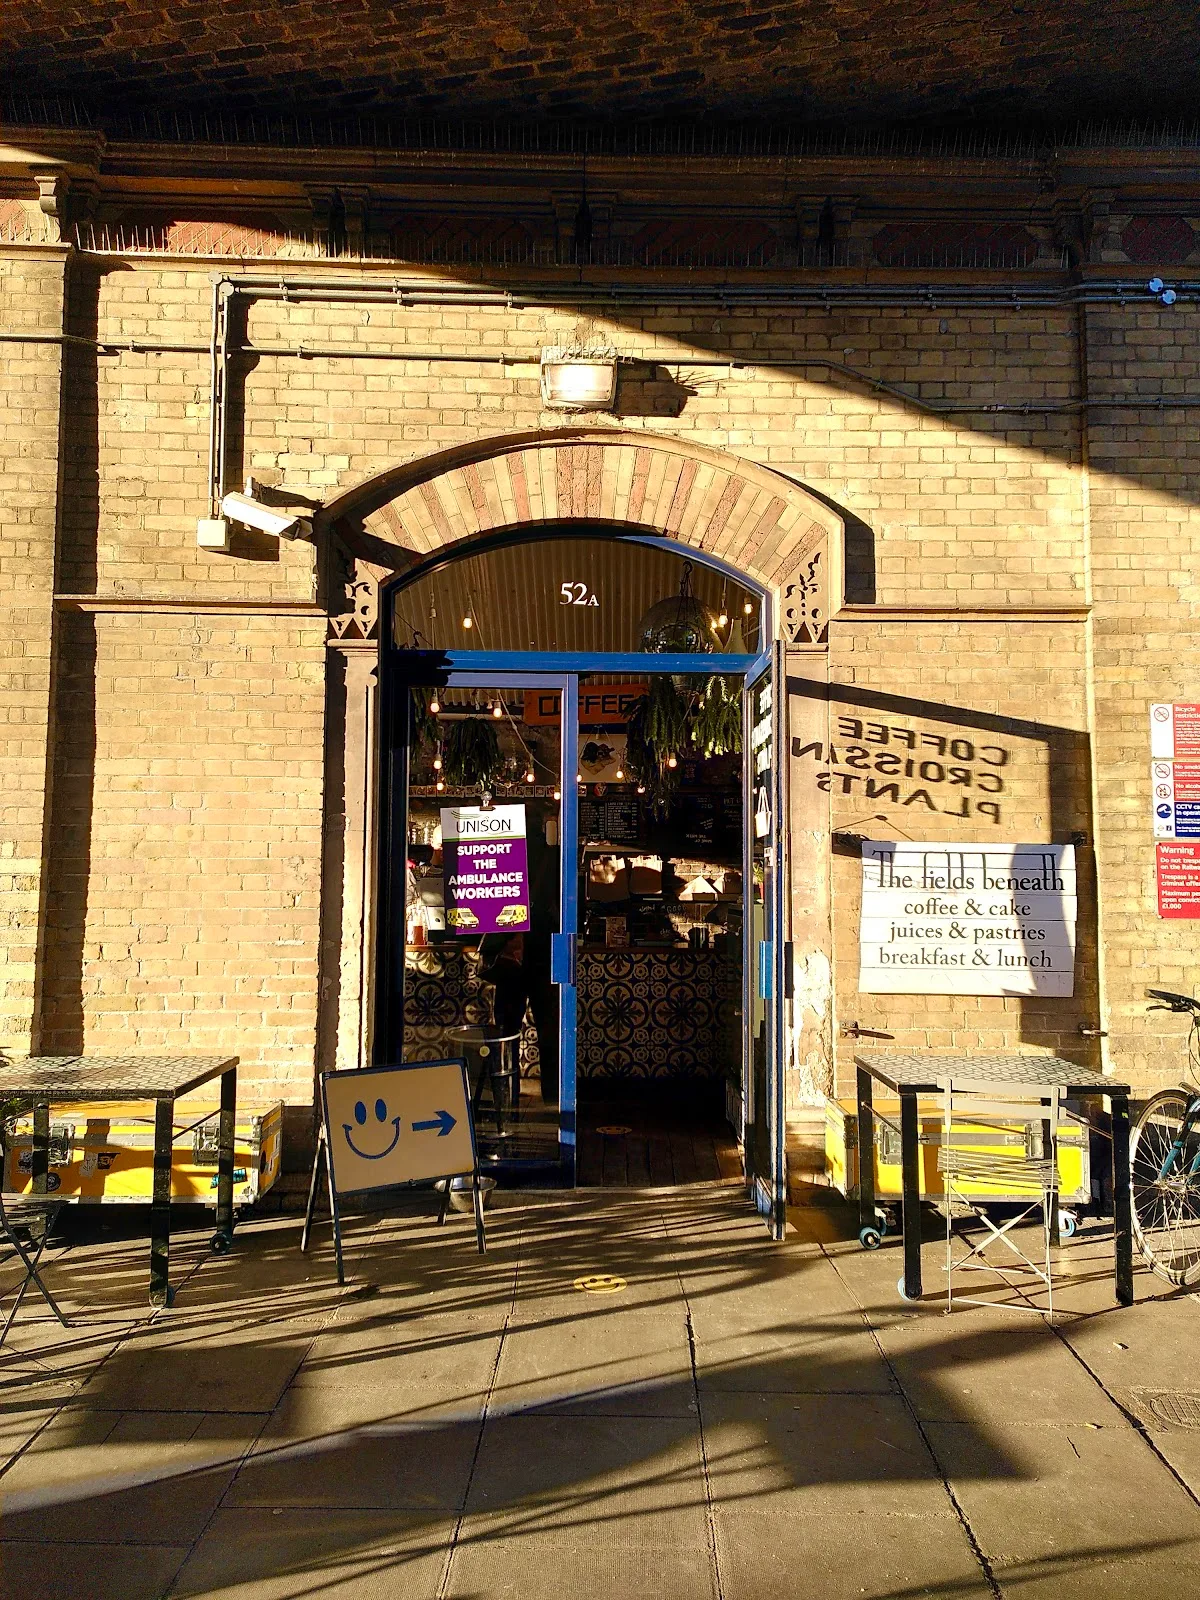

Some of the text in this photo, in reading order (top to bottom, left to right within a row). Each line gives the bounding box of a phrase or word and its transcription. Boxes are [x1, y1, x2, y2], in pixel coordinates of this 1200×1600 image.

[559, 581, 600, 607] 52A
[456, 818, 511, 833] UNISON
[457, 843, 512, 856] SUPPORT
[1160, 846, 1195, 856] Warning
[473, 859, 497, 870] THE
[872, 850, 1065, 891] The fields beneath
[448, 872, 523, 885] AMBULANCE
[452, 885, 520, 900] WORKERS
[904, 898, 1031, 916] coffee & cake
[888, 921, 1046, 944] juices & pastries
[879, 946, 1052, 968] breakfast & lunch
